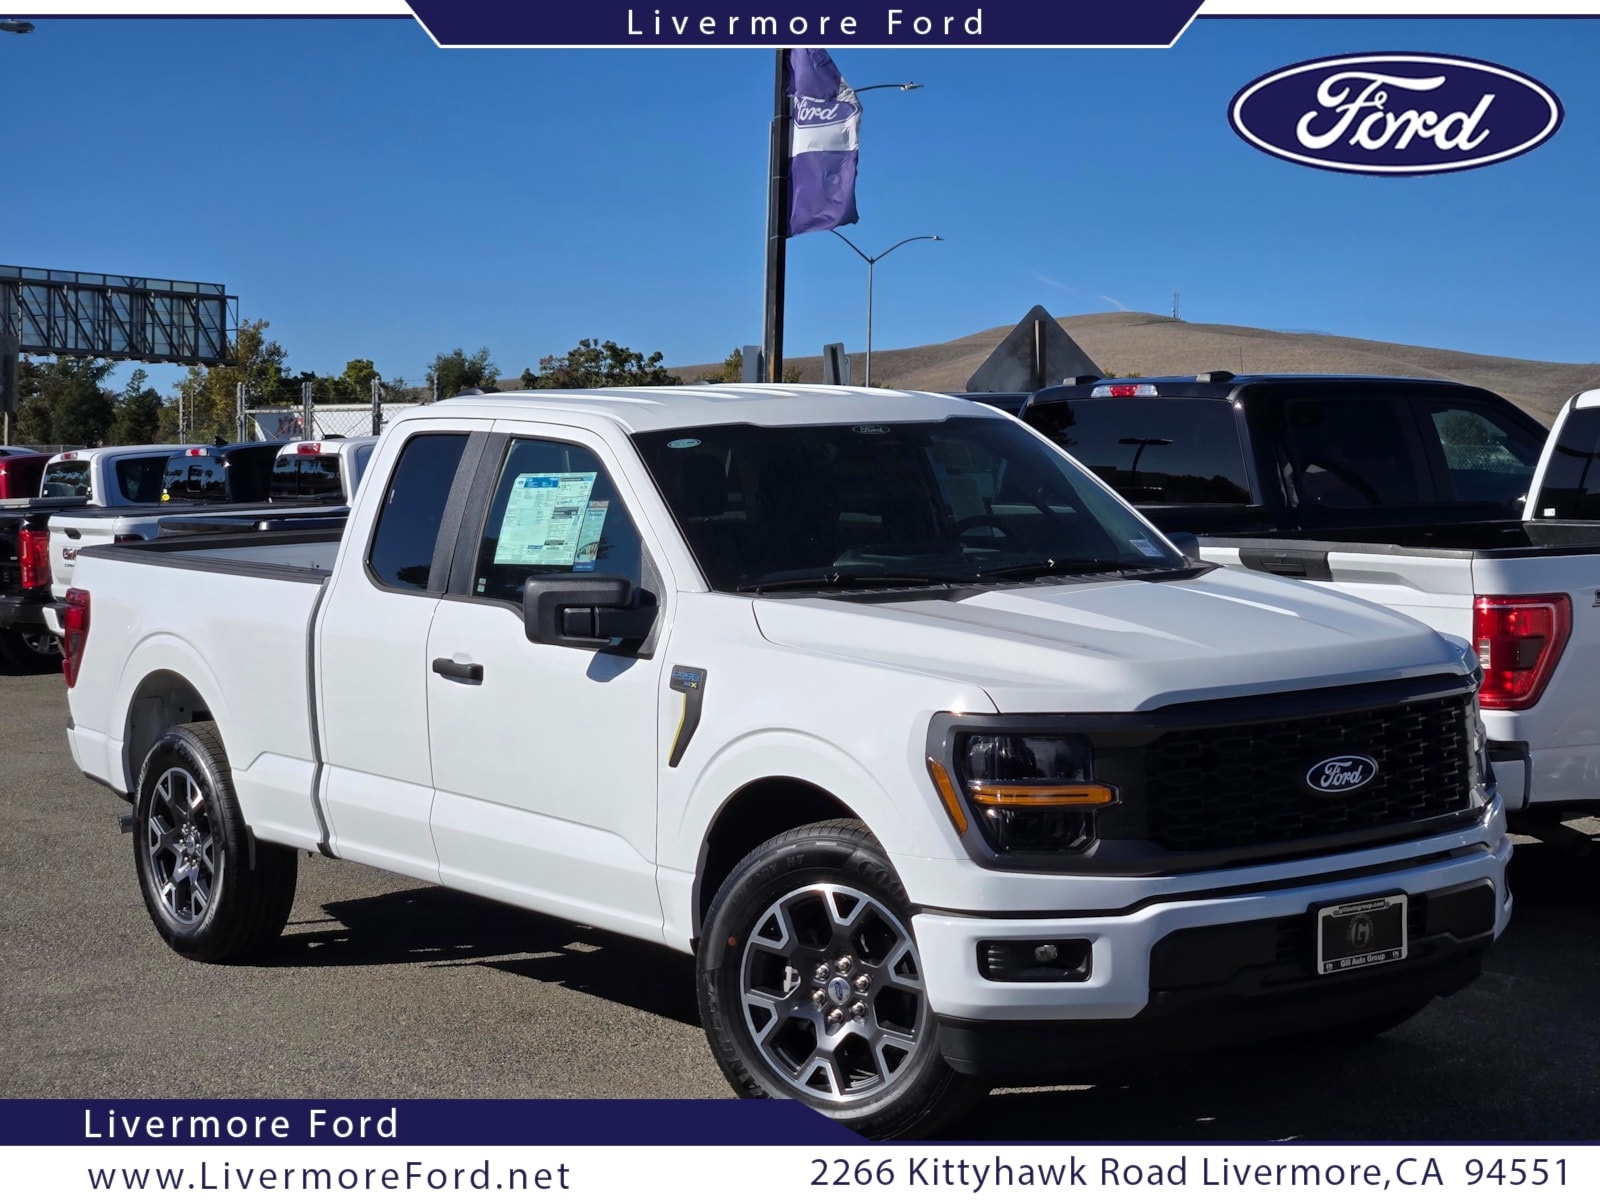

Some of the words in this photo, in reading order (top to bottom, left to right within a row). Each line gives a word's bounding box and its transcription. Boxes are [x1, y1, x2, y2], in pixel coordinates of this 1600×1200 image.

[793, 95, 840, 122] Ford
[1320, 760, 1363, 788] Ford
[1341, 958, 1351, 967] Gill
[1351, 957, 1366, 966] Auto
[1368, 954, 1385, 962] Group
